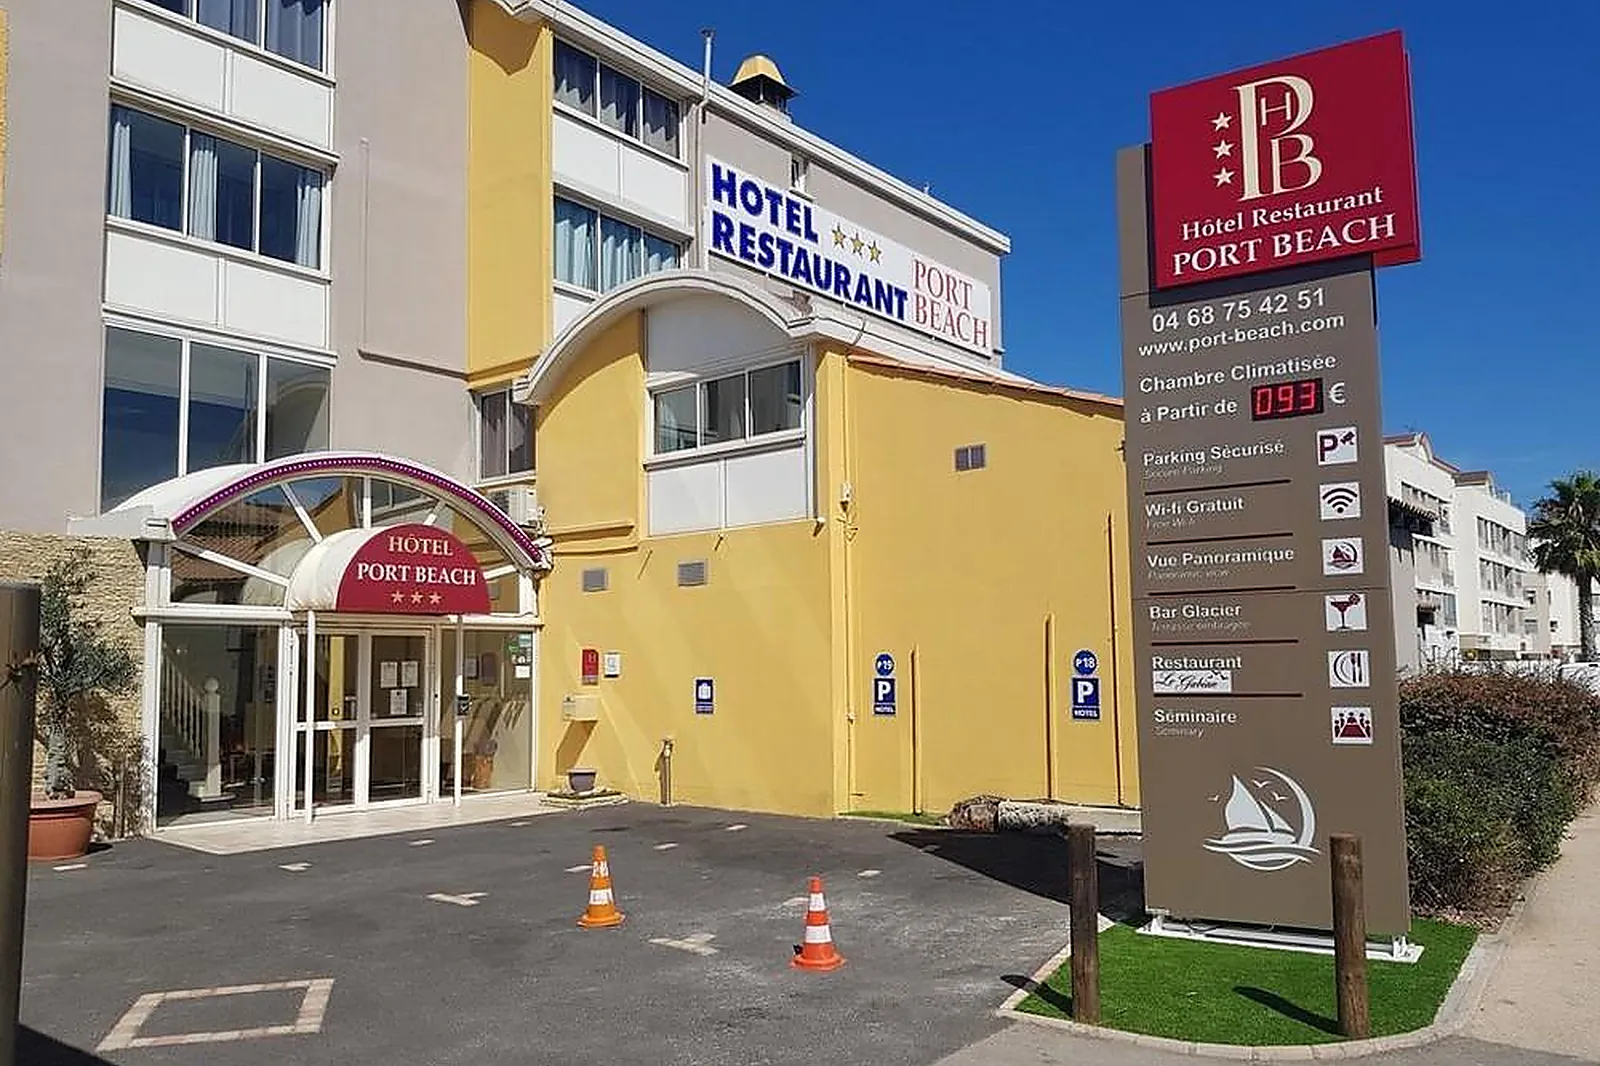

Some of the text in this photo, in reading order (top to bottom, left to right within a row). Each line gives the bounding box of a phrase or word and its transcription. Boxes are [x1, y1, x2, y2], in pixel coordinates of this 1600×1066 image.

[711, 162, 819, 244] HOTEL
[1182, 186, 1383, 241] Hôtel Restaurant
[1173, 213, 1396, 276] PORT BEACH
[712, 210, 908, 321] RESTAURANT
[912, 259, 973, 310] PORT
[912, 292, 988, 348] BEACH
[1152, 287, 1324, 332] 04 68 75 42 51
[1138, 314, 1345, 356] www.port-beach.com
[1140, 369, 1225, 393] Chambre
[1141, 382, 1346, 424] à Partir de €
[1255, 382, 1316, 415] 093
[1143, 451, 1205, 467] Parking
[1186, 497, 1244, 514] Gratuit
[389, 533, 454, 556] HÔTEL
[1147, 549, 1294, 568] Vue Panoramique
[357, 562, 476, 586] PORT BEACH
[1150, 604, 1242, 619] Bar Glacier
[1152, 655, 1243, 670] Restaurant
[878, 681, 891, 701] P
[1077, 681, 1094, 703] P
[1154, 708, 1237, 724] Séminaire
